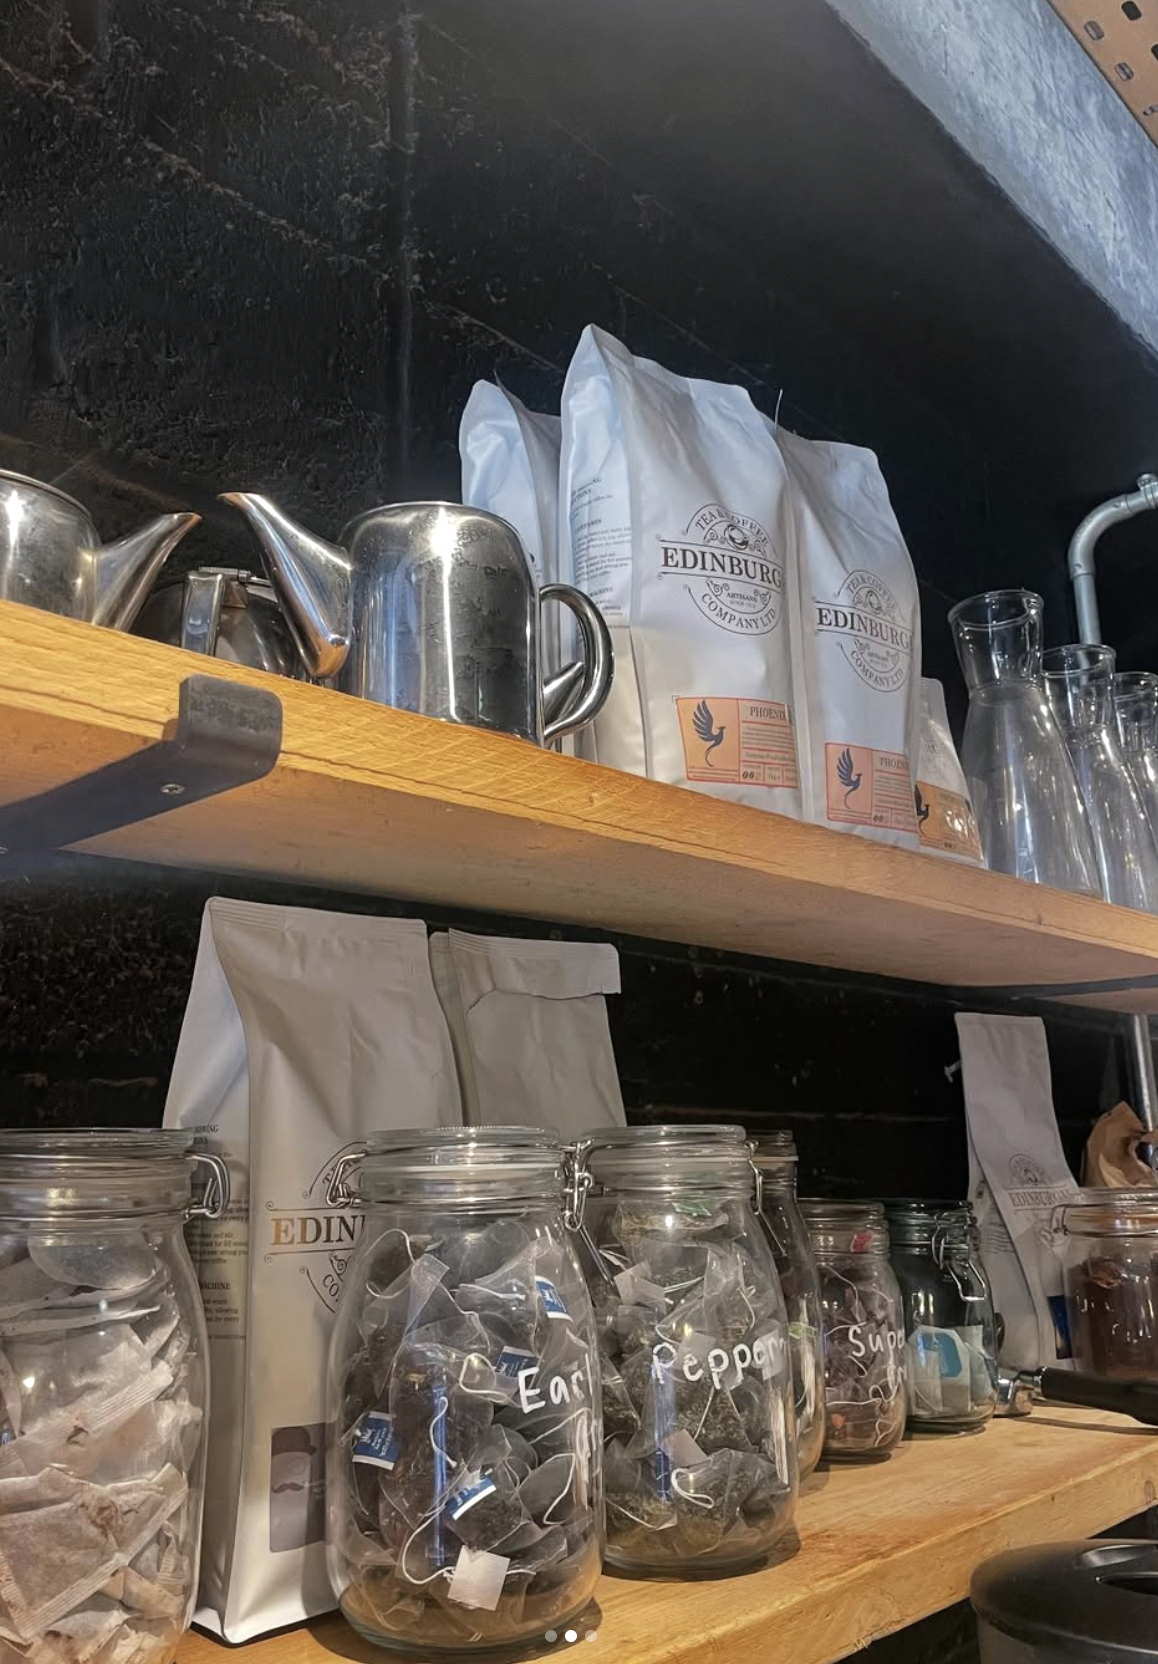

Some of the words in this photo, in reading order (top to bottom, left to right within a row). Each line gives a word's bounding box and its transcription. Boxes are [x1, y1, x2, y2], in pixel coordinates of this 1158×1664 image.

[695, 510, 718, 531] TEA
[661, 546, 784, 590] EDINBURG
[702, 593, 759, 629] COMPANY
[322, 1274, 341, 1302] CO
